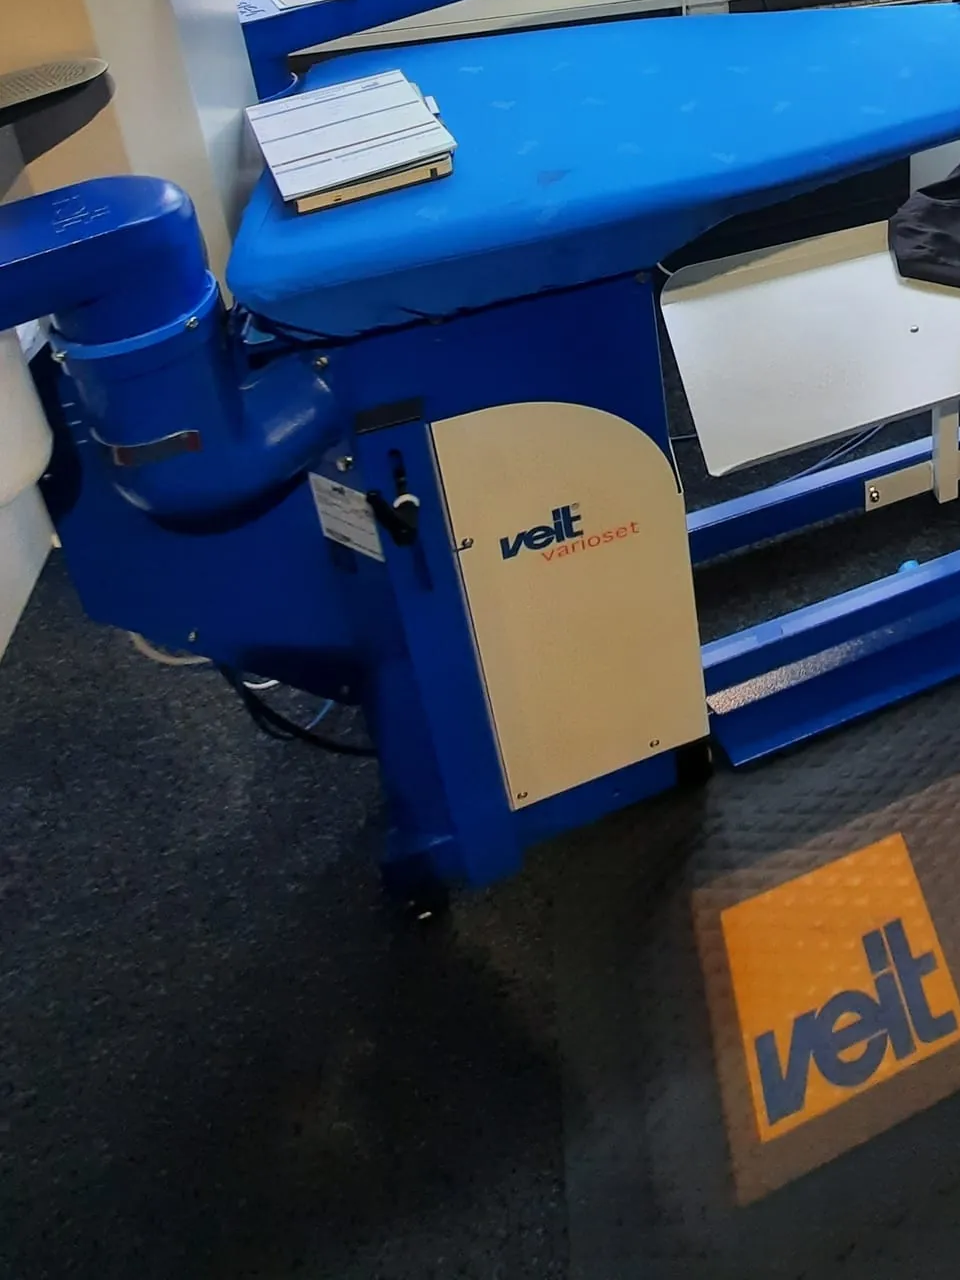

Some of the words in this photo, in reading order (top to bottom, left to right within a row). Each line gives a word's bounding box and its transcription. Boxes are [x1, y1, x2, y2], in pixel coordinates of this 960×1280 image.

[500, 504, 584, 560] veit
[541, 521, 640, 562] varioset
[755, 918, 959, 1126] veit
